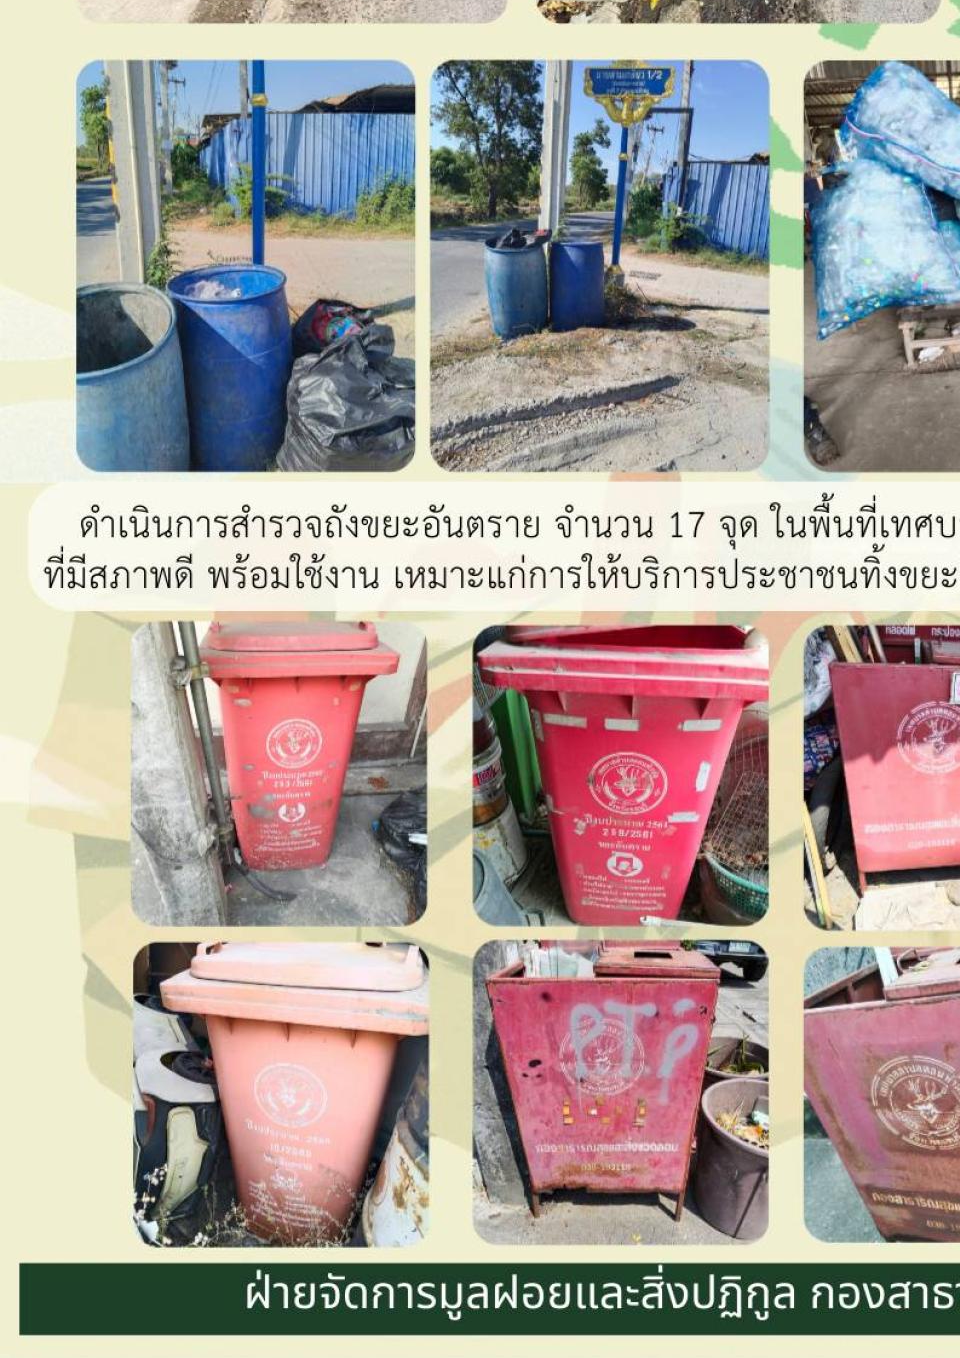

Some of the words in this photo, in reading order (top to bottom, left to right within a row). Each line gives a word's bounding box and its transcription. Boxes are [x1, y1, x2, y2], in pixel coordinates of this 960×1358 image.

[80, 504, 540, 539] ดำเนินการสำรวจถังขยะอันตราย
[555, 504, 653, 538] จำนวน
[671, 511, 705, 538] 17
[719, 516, 758, 550] จุด
[44, 546, 193, 589] ที่มีสภาพดี
[207, 552, 379, 589] พร้อมใช้งาน
[246, 1265, 795, 1321] ฝ่ายจัดการมูลฝอยและสิ่งปฏิกูล
